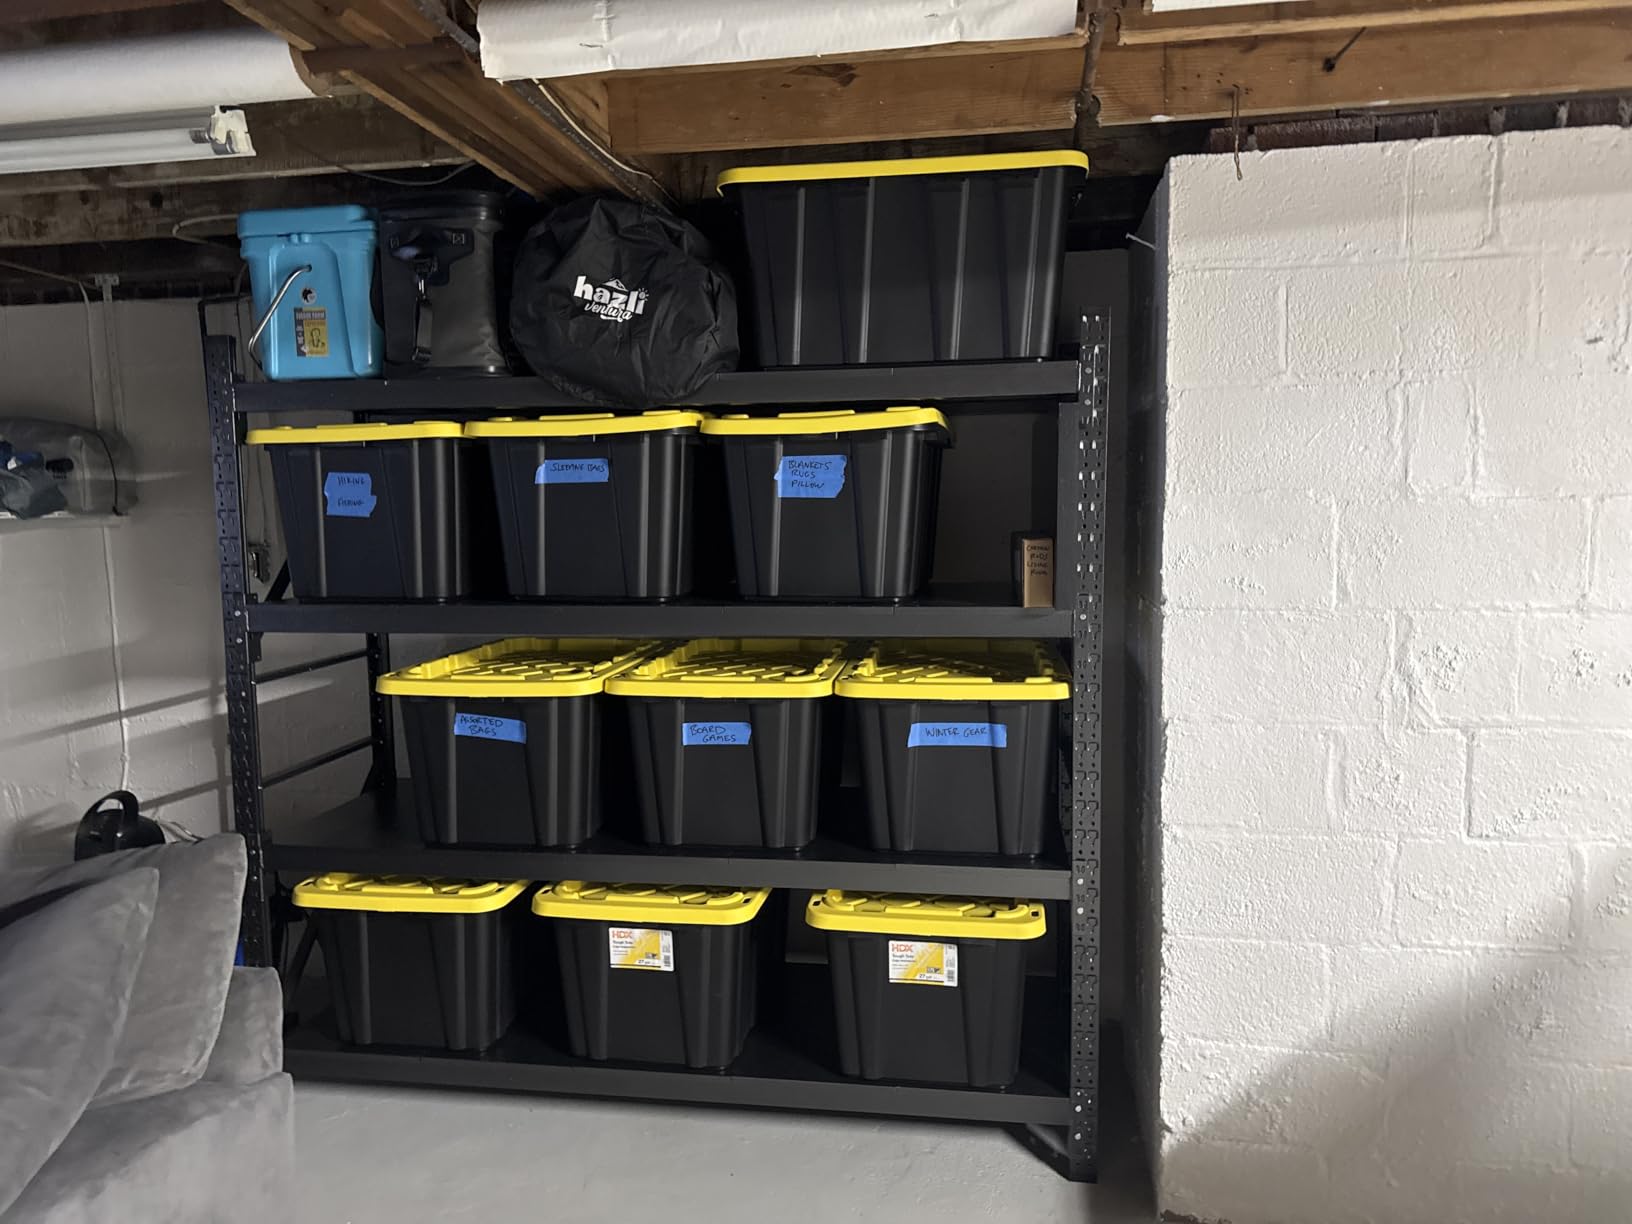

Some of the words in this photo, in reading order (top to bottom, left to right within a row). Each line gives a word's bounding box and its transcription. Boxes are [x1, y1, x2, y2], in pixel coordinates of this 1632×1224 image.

[573, 275, 647, 315] hazli
[584, 302, 633, 323] ventura
[788, 460, 832, 470] BLANKETS
[791, 469, 816, 479] RUGS
[791, 480, 824, 489] PILLOW
[469, 725, 497, 736] BAGS
[690, 724, 726, 736] BOARD
[925, 727, 960, 737] WINTER
[963, 727, 987, 737] GEAR
[702, 734, 736, 743] GAMES
[612, 930, 633, 939] HDX
[891, 943, 913, 952] HDX
